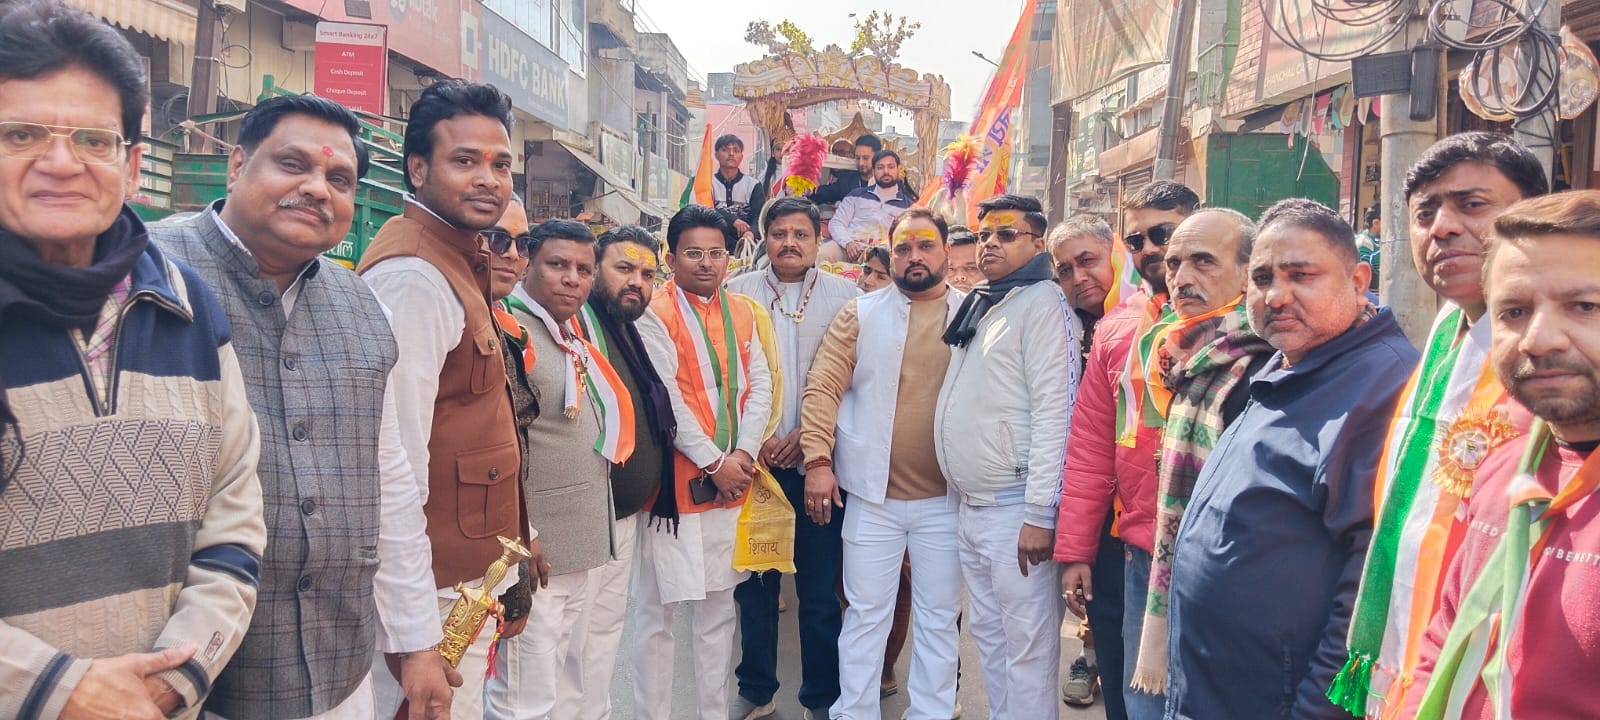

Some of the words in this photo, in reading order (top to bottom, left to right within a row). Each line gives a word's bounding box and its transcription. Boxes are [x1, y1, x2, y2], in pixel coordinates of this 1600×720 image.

[339, 31, 362, 39] Banking
[344, 69, 364, 77] Deposit
[488, 33, 528, 89] HDFC
[532, 62, 566, 110] BANK
[326, 87, 346, 95] Cheque
[346, 88, 366, 96] Deposit
